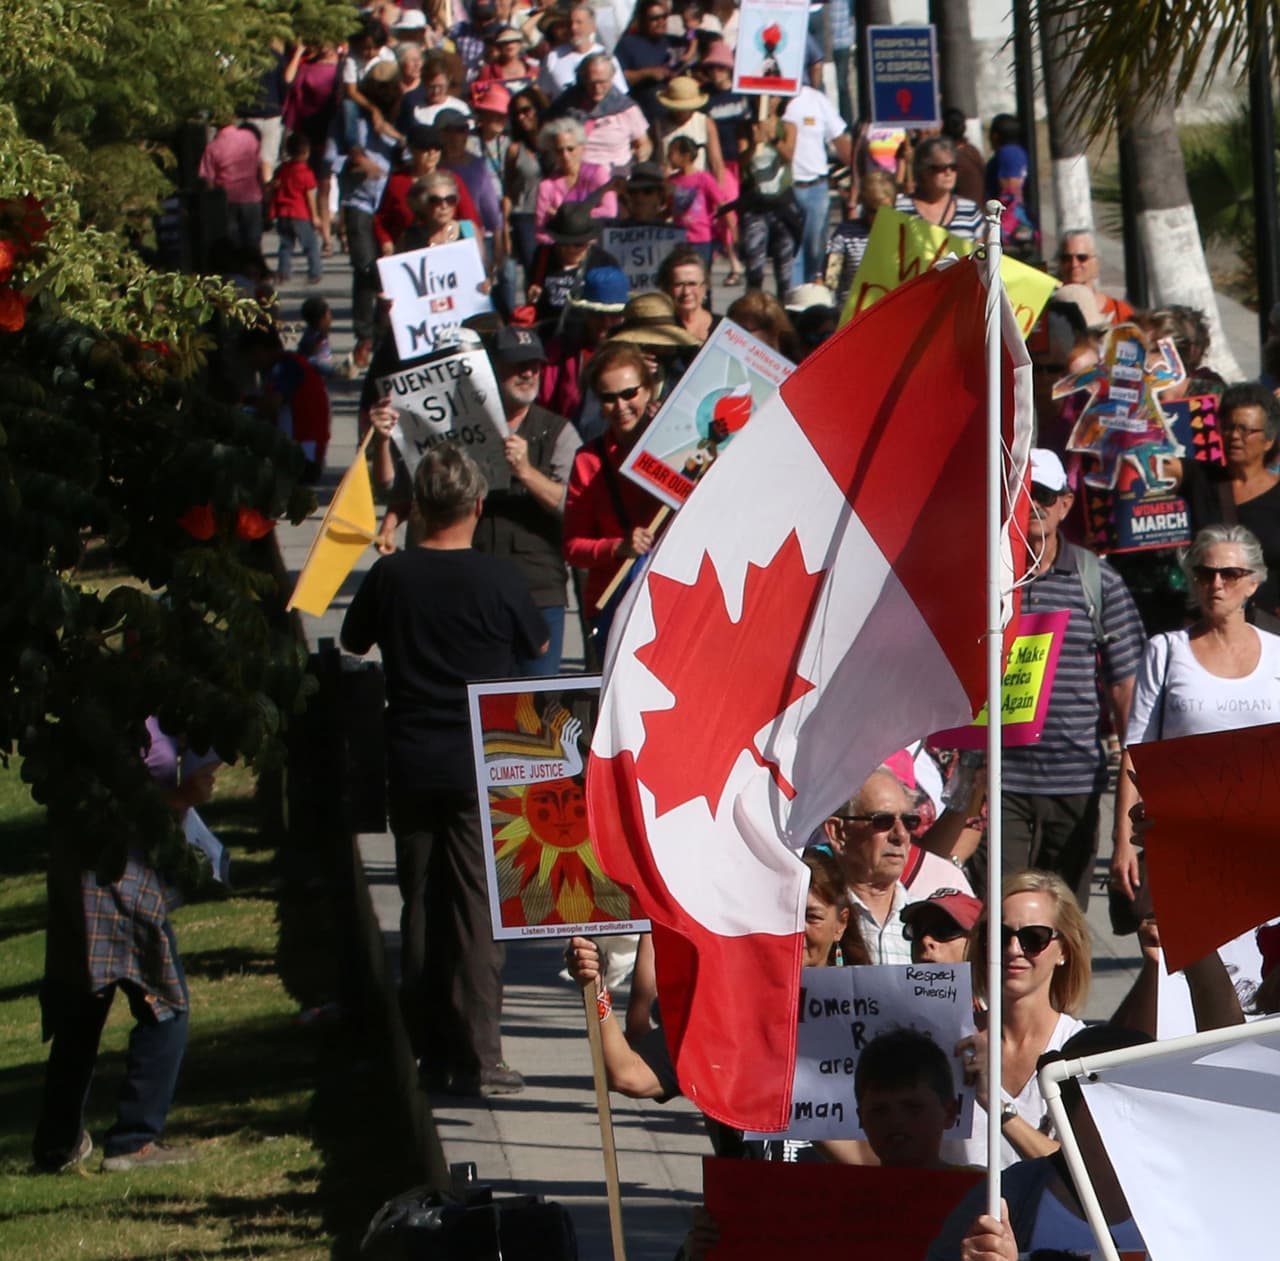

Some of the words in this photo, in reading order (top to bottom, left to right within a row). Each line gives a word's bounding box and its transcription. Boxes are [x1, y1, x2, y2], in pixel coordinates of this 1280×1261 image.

[609, 229, 675, 244] PUENTES
[401, 256, 457, 297] Viva
[383, 357, 473, 395] PUENTES
[638, 457, 668, 484] HEAR
[668, 474, 695, 499] OUR
[1132, 500, 1186, 517] WOMEN'S
[1131, 512, 1188, 534] MARCH
[1016, 646, 1045, 664] Make
[1001, 669, 1032, 688] erica
[1001, 692, 1034, 714] Again
[1216, 698, 1271, 712] WOMAN
[490, 765, 526, 782] CLIMATE
[529, 762, 564, 779] JUSTICE
[521, 925, 548, 936] Listen
[549, 925, 556, 934] to
[557, 923, 583, 937] people
[584, 922, 599, 932] not
[599, 920, 633, 934] polluters
[906, 966, 956, 986] Respect
[914, 986, 957, 1003] Diversity
[819, 1057, 854, 1075] are
